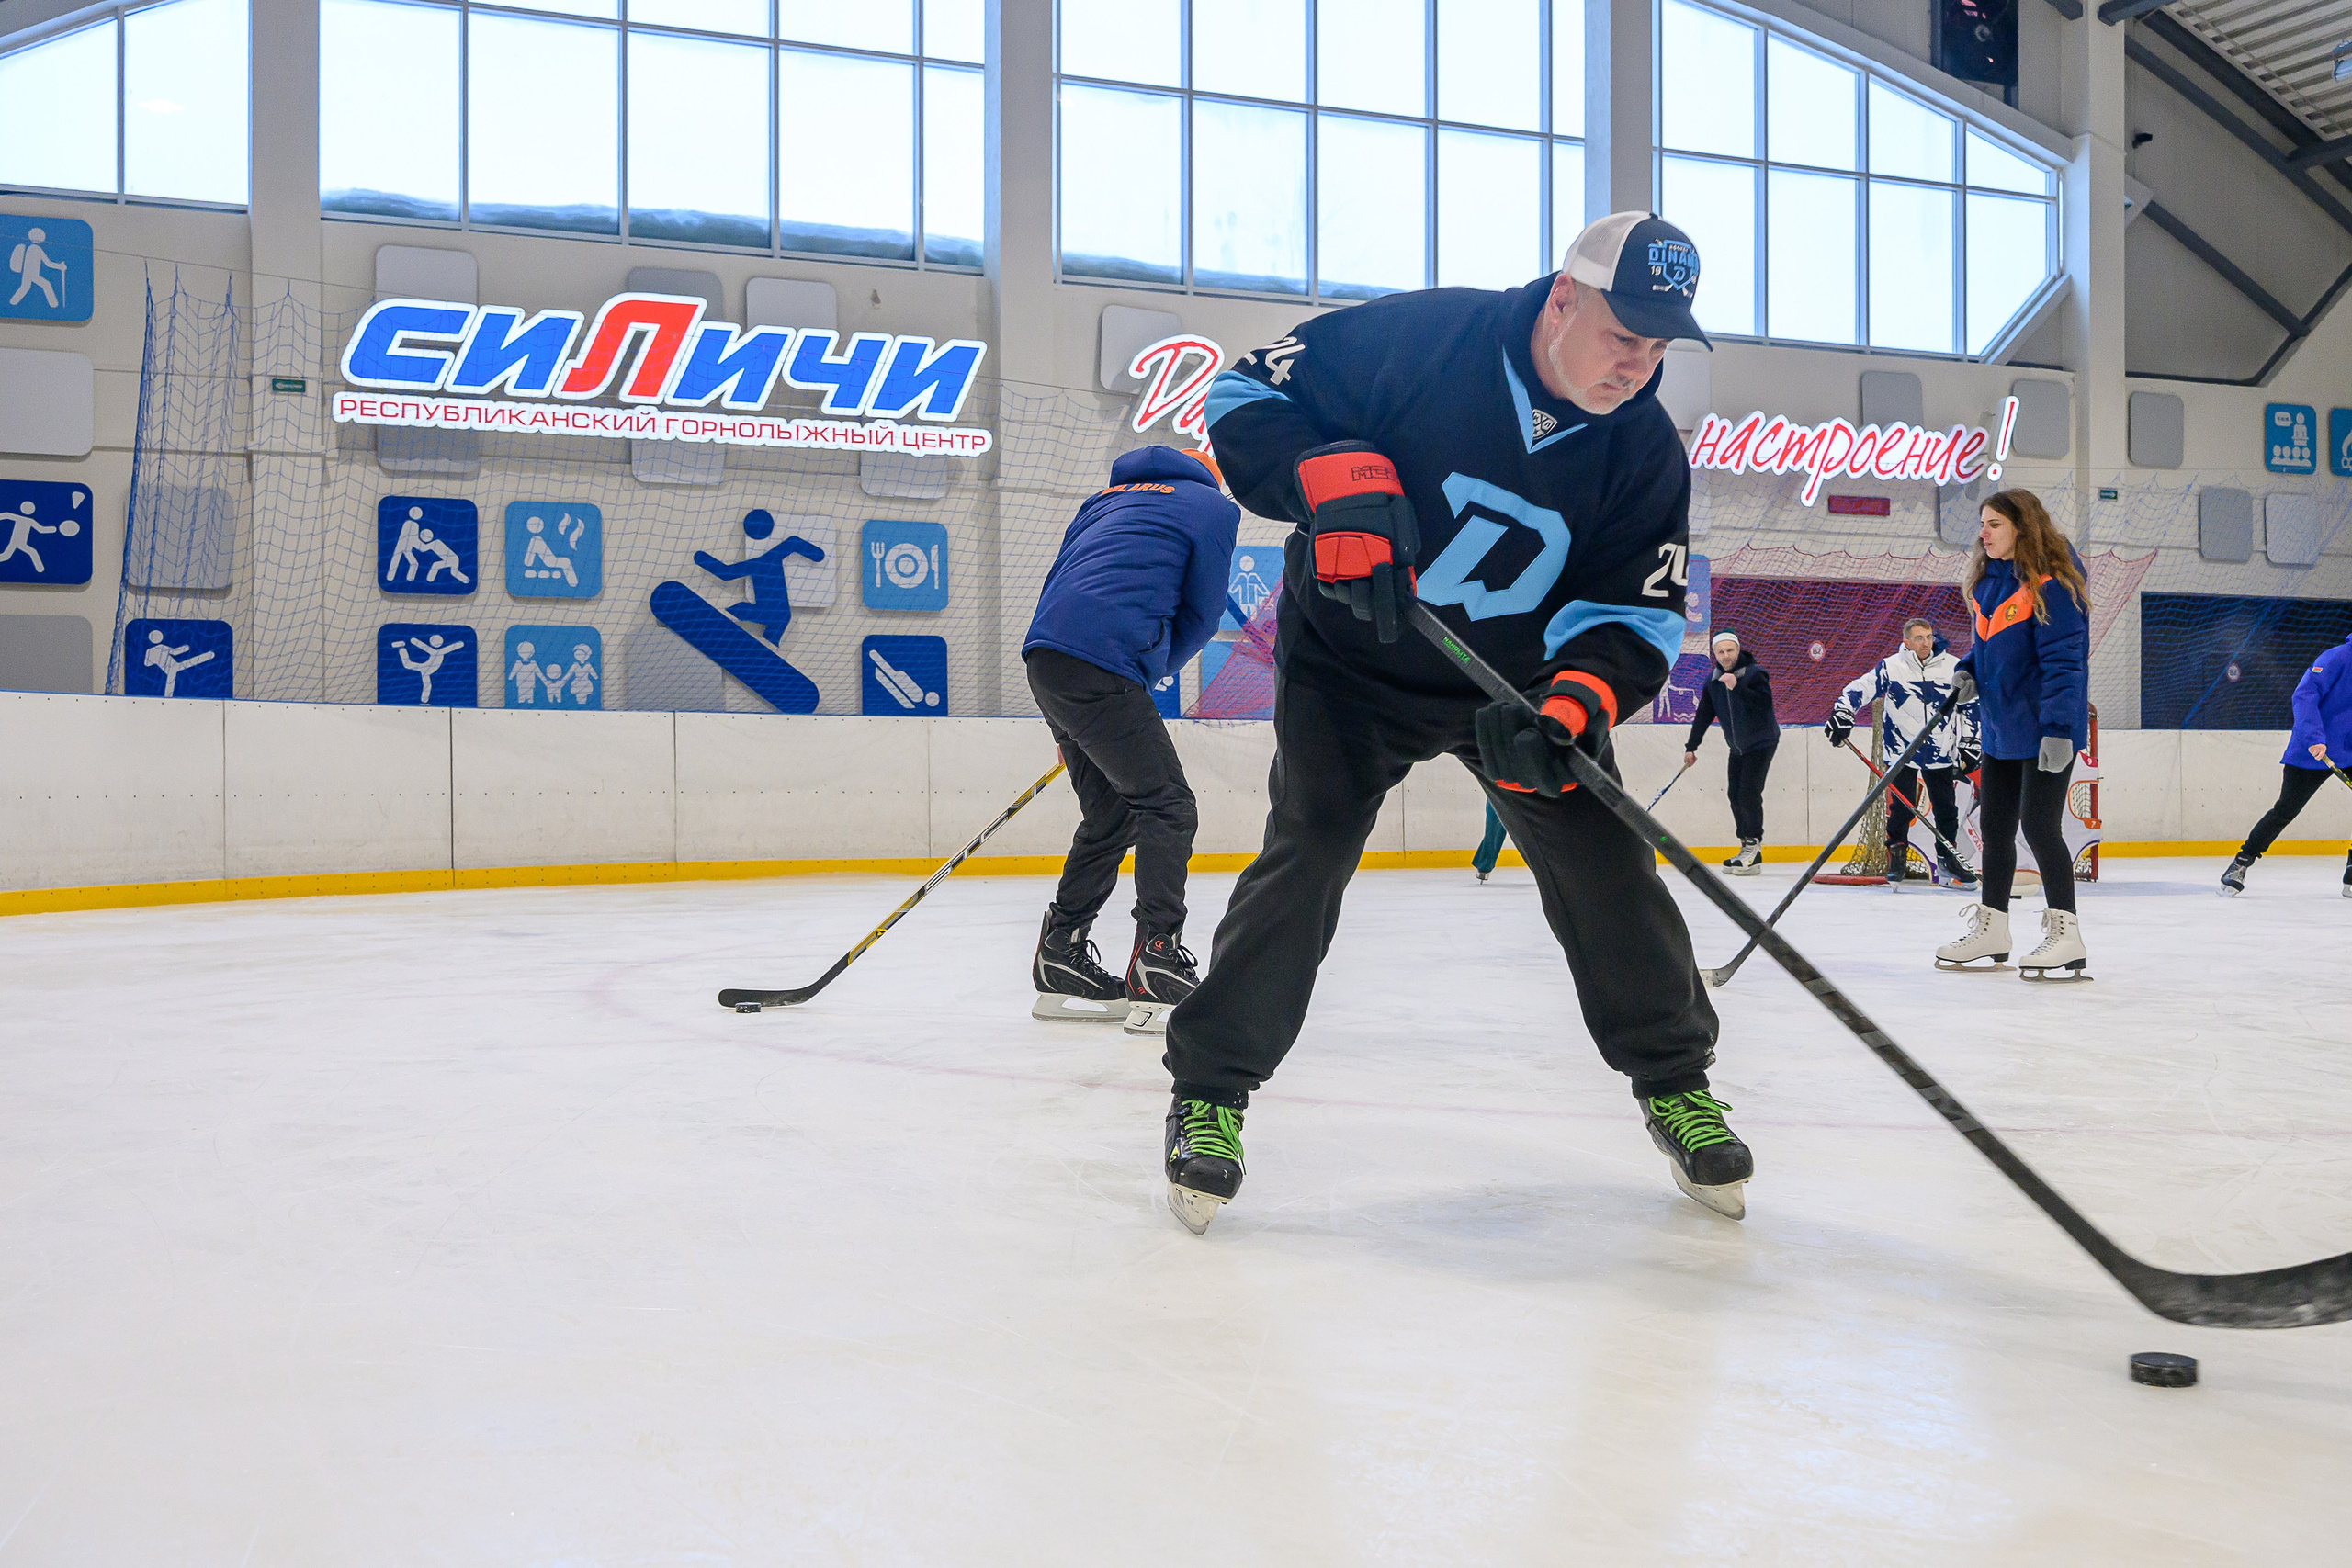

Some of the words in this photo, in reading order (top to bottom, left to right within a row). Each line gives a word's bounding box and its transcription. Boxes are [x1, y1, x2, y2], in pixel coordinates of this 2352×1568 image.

[339, 399, 657, 434] РЕСПУБЛИКАНСКИЙ
[665, 418, 895, 446] ГОРНОЛЫЖНЫЙ
[902, 431, 986, 450] ЦЕНТР
